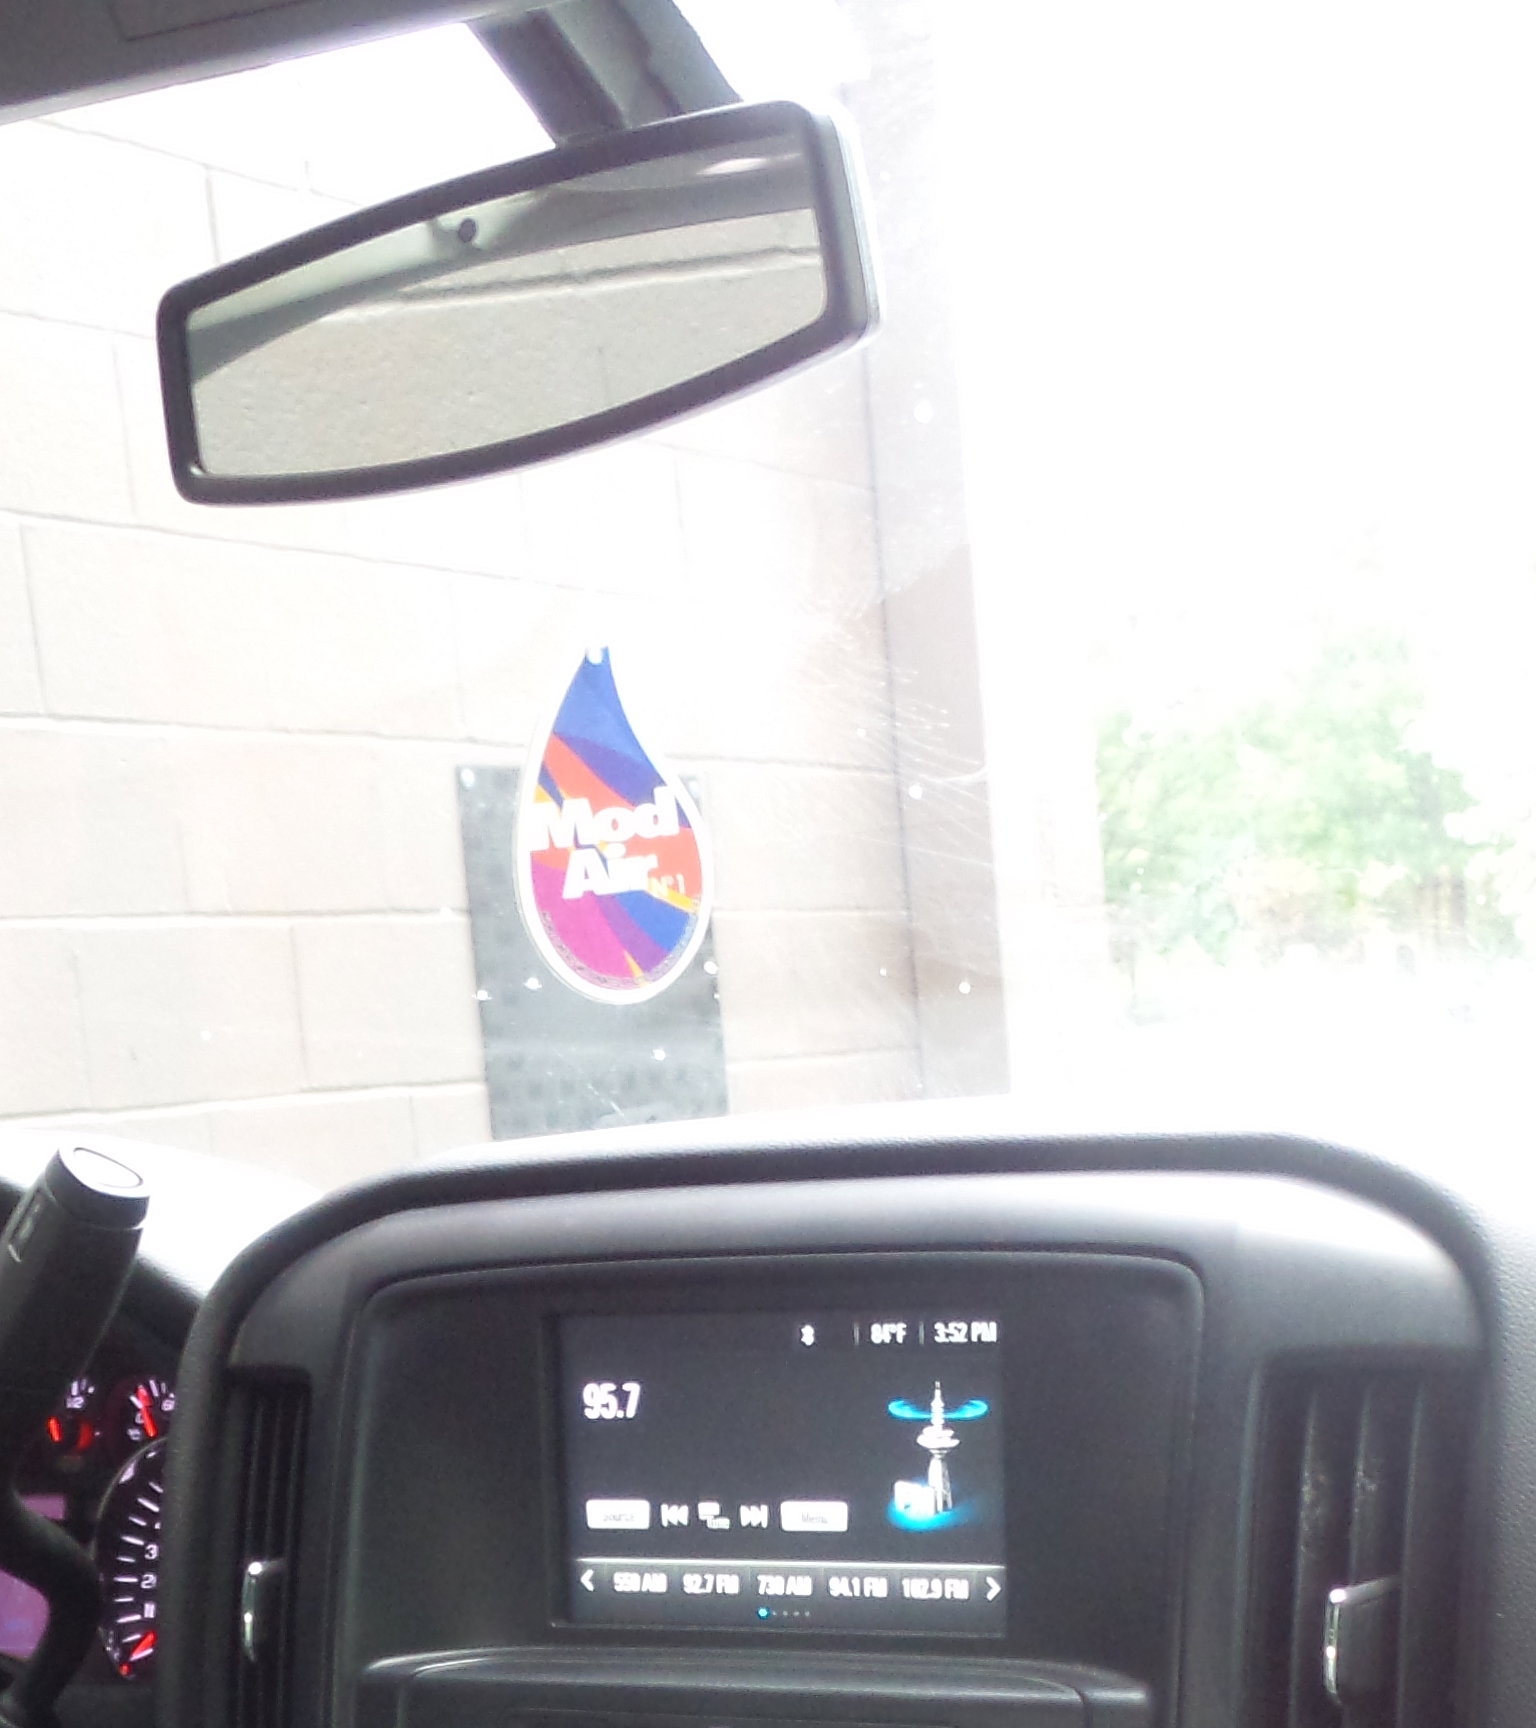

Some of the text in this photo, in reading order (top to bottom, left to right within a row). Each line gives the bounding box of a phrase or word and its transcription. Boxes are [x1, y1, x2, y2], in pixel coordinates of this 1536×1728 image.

[562, 842, 659, 900] Air
[934, 1321, 997, 1342] 3:52 PM
[583, 1382, 641, 1420] 95.7
[641, 1572, 667, 1593] AM
[716, 1574, 739, 1594] FM
[785, 1575, 812, 1596] AM
[863, 1576, 888, 1598] FM
[944, 1578, 969, 1599] FM
